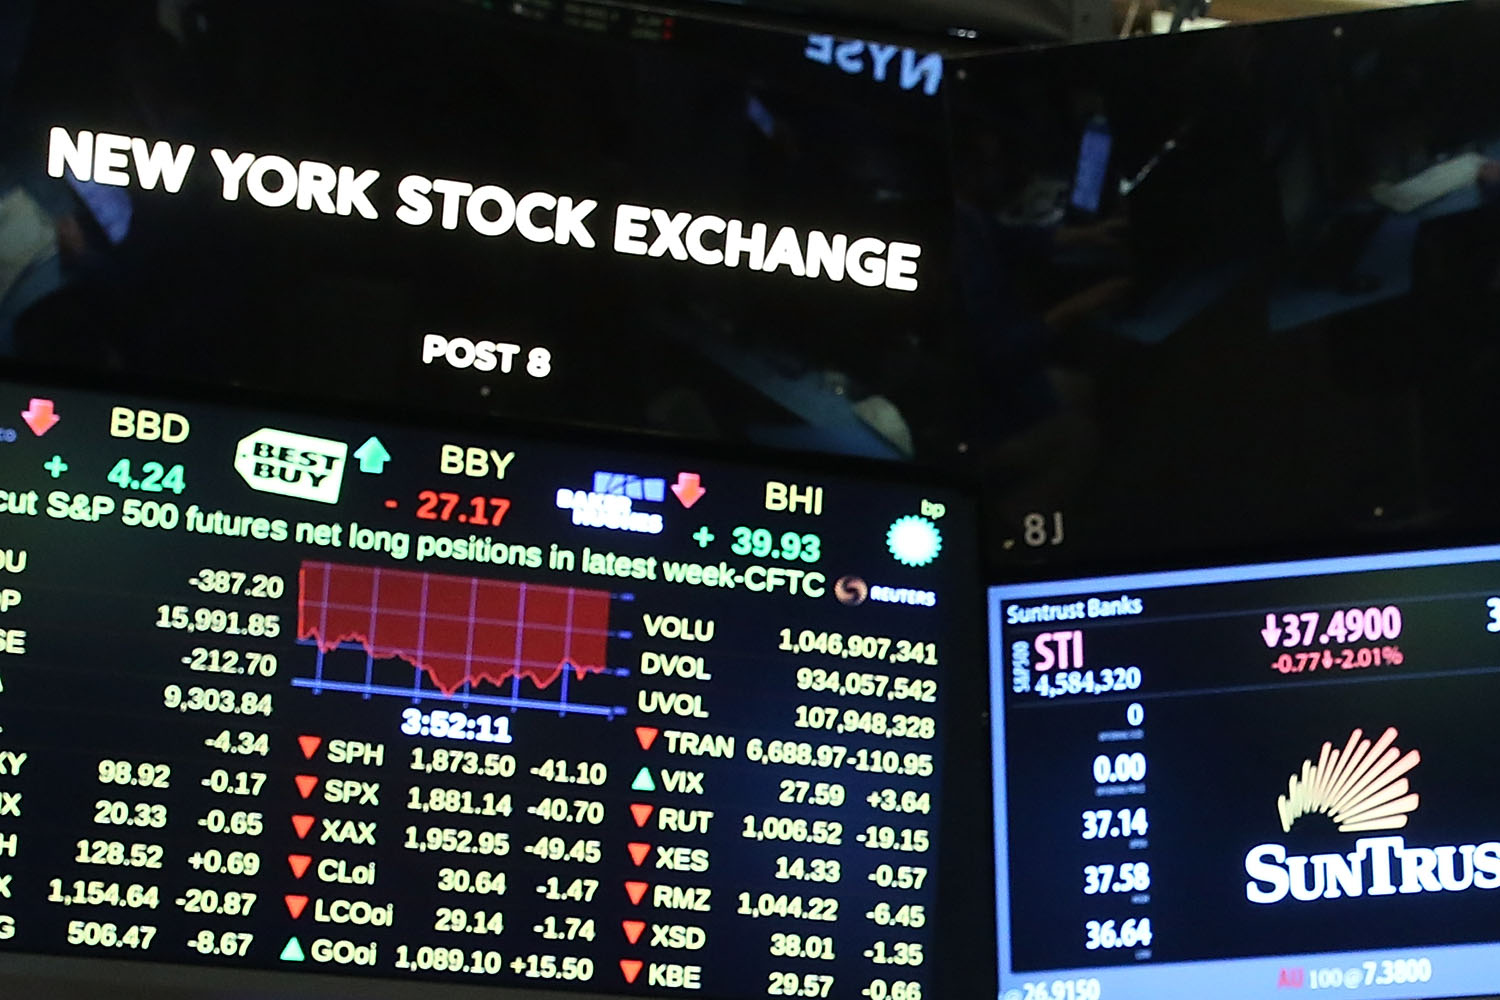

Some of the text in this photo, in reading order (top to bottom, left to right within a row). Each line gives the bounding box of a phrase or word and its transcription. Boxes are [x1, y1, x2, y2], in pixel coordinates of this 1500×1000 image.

[46, 126, 921, 292] NEW YORK STOCK EXCHANGE
[421, 334, 552, 379] POST 8
[110, 406, 190, 444] BBD
[253, 442, 340, 470] BEST
[440, 444, 515, 479] BBY
[107, 459, 186, 494] 4.24
[253, 462, 328, 488] BUY
[417, 490, 511, 526] 27.17
[765, 481, 823, 515] BHI
[920, 499, 946, 519] bp
[46, 491, 115, 522] S&P
[122, 499, 179, 530] 500
[185, 508, 289, 542] futures
[295, 521, 342, 548] net
[349, 523, 410, 559] long
[416, 531, 542, 569] positions
[549, 543, 574, 572] in
[582, 547, 657, 581] latest
[663, 559, 826, 598] week-CFTC
[731, 526, 822, 562] 39.93
[1024, 512, 1064, 546] 8J
[188, 568, 284, 598] -387.20
[155, 603, 281, 638] 15,991.85
[1007, 595, 1143, 624] Suntrust Banks
[1282, 605, 1402, 648] 37.4900
[642, 613, 938, 666] VOLU 1,046,907,341
[1034, 630, 1083, 672] STI
[181, 646, 278, 677] -212.70
[640, 652, 938, 703] DVOL 934,057,542
[1034, 666, 1141, 698] 4,584,320
[163, 684, 273, 717] 9,303.84
[637, 690, 936, 740] UVOL 107,948,328
[1126, 703, 1144, 726] 0
[204, 729, 270, 756] -4.34
[400, 708, 512, 743] 3:52:11
[327, 740, 608, 785] SPH 1,873.50 -41.10
[662, 729, 933, 777] TRAN 6,688.97 -110.95
[1093, 752, 1146, 784] 0.00
[98, 759, 268, 797] 98.92 -0.17
[660, 768, 931, 815] VIX 27.59 +3.64
[93, 800, 264, 837] 20.33 -0.65
[324, 779, 605, 825] SPX 1,881.14 -40.70
[319, 818, 602, 864] XAX 1,952.95 -49.45
[658, 807, 930, 853] RUT 1,006.52 -19.15
[1082, 807, 1149, 839] 37.14
[75, 839, 164, 869] 128.52
[187, 849, 260, 876] +0.69
[655, 846, 928, 890] XES 14.33 -0.57
[437, 868, 507, 896] 30.64
[536, 876, 599, 902] -1.47
[1083, 862, 1151, 895] 37.58
[47, 878, 159, 910] 1,154.64
[174, 888, 257, 917] -20.87
[653, 884, 926, 928] RMZ 1,044.22 -6.45
[67, 920, 157, 950] 506.47
[186, 929, 254, 957] -8.67
[434, 907, 504, 935] 29.14
[533, 916, 596, 942] -1.74
[1085, 917, 1153, 950] 36.64
[651, 923, 924, 966] XSD 38.01 -1.35
[395, 945, 501, 974] 1,089.10
[510, 954, 594, 981] +15.50
[648, 963, 702, 989] KBE
[768, 972, 834, 999] 29.57
